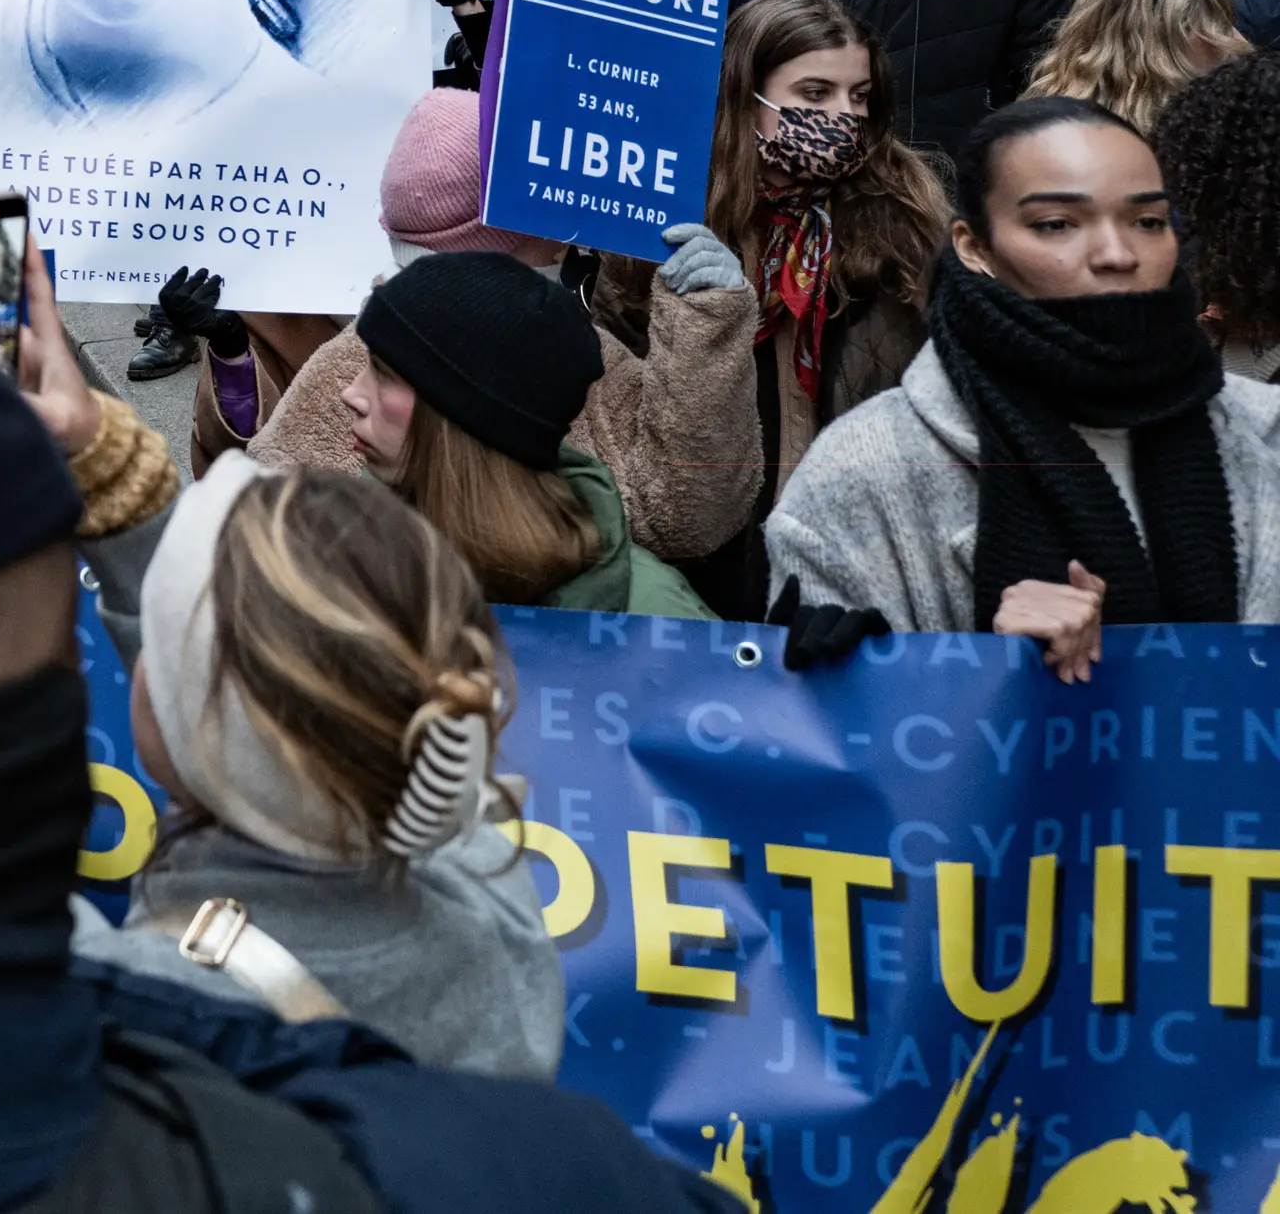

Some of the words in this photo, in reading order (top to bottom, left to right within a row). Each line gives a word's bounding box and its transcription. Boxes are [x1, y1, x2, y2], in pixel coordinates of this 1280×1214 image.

[568, 53, 582, 70] L.
[588, 58, 660, 88] CURNIER
[578, 93, 597, 110] 53
[602, 97, 640, 123] ANS,
[1, 147, 50, 172] ÉTÉ
[63, 150, 135, 176] TUÉE
[149, 161, 201, 181] PAR
[216, 164, 290, 185] TAHA
[302, 168, 346, 191] O.,
[527, 120, 678, 194] LIBRE
[164, 192, 327, 218] MAROCAIN
[529, 182, 537, 197] 7
[542, 186, 575, 206] ANS
[580, 193, 620, 215] PLUS
[626, 204, 668, 226] TARD
[132, 223, 205, 243] SOUS
[217, 227, 297, 250] OQTF
